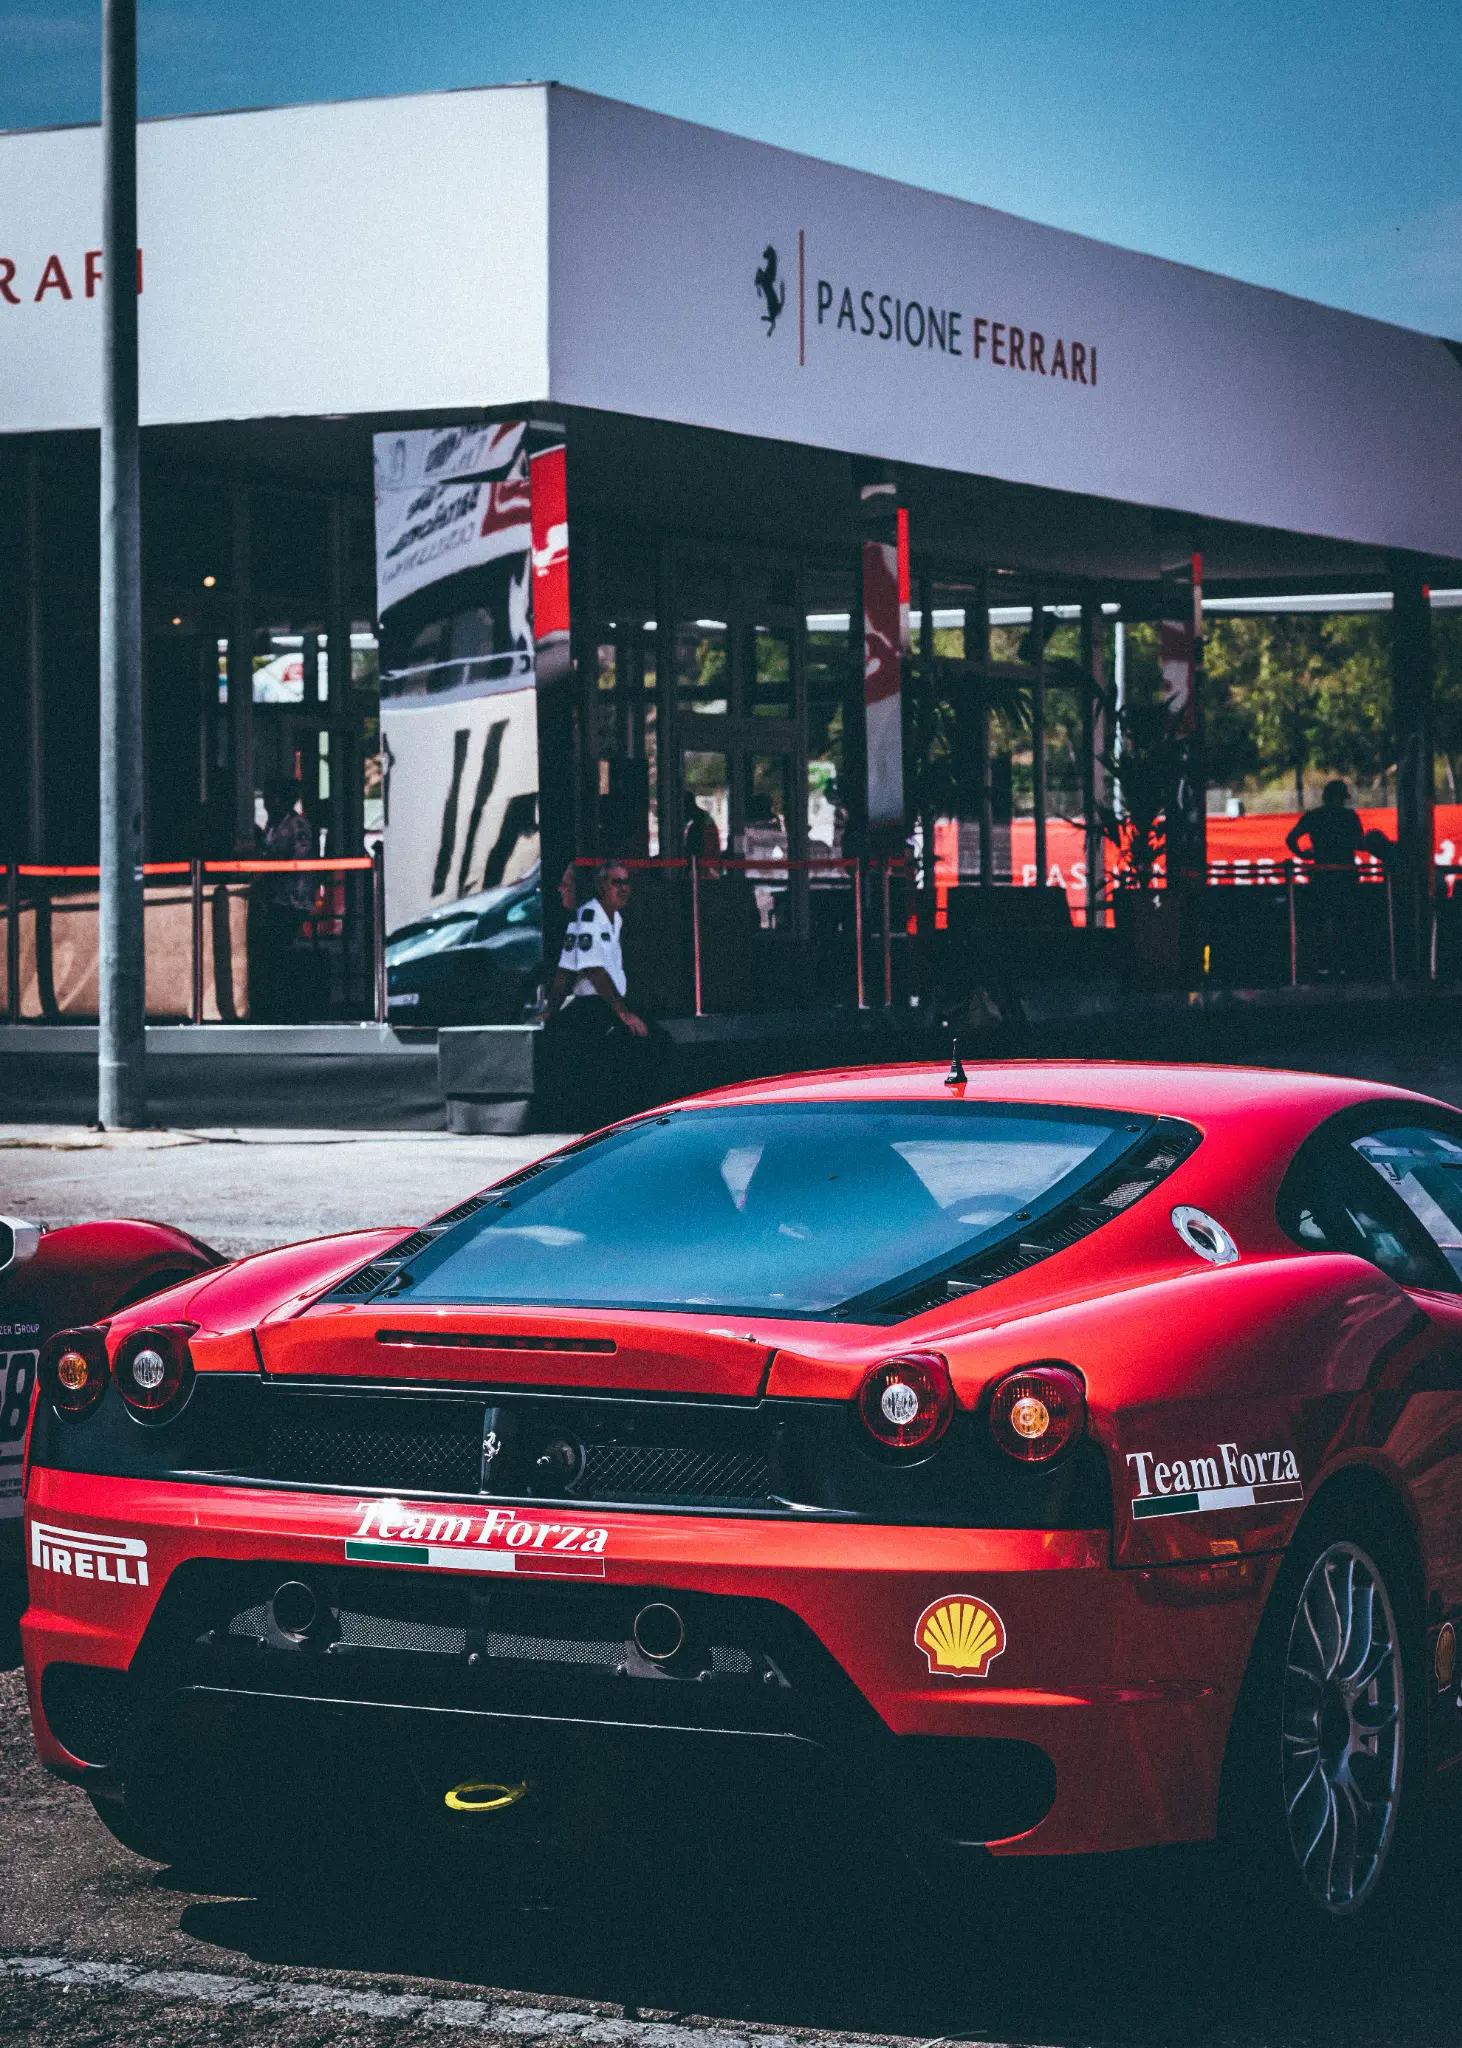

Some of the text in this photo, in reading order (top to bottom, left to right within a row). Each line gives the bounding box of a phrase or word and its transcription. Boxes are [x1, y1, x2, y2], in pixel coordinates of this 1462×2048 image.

[817, 279, 1097, 387] PASSIONE FERRARI
[31, 1520, 149, 1586] PIRELLI
